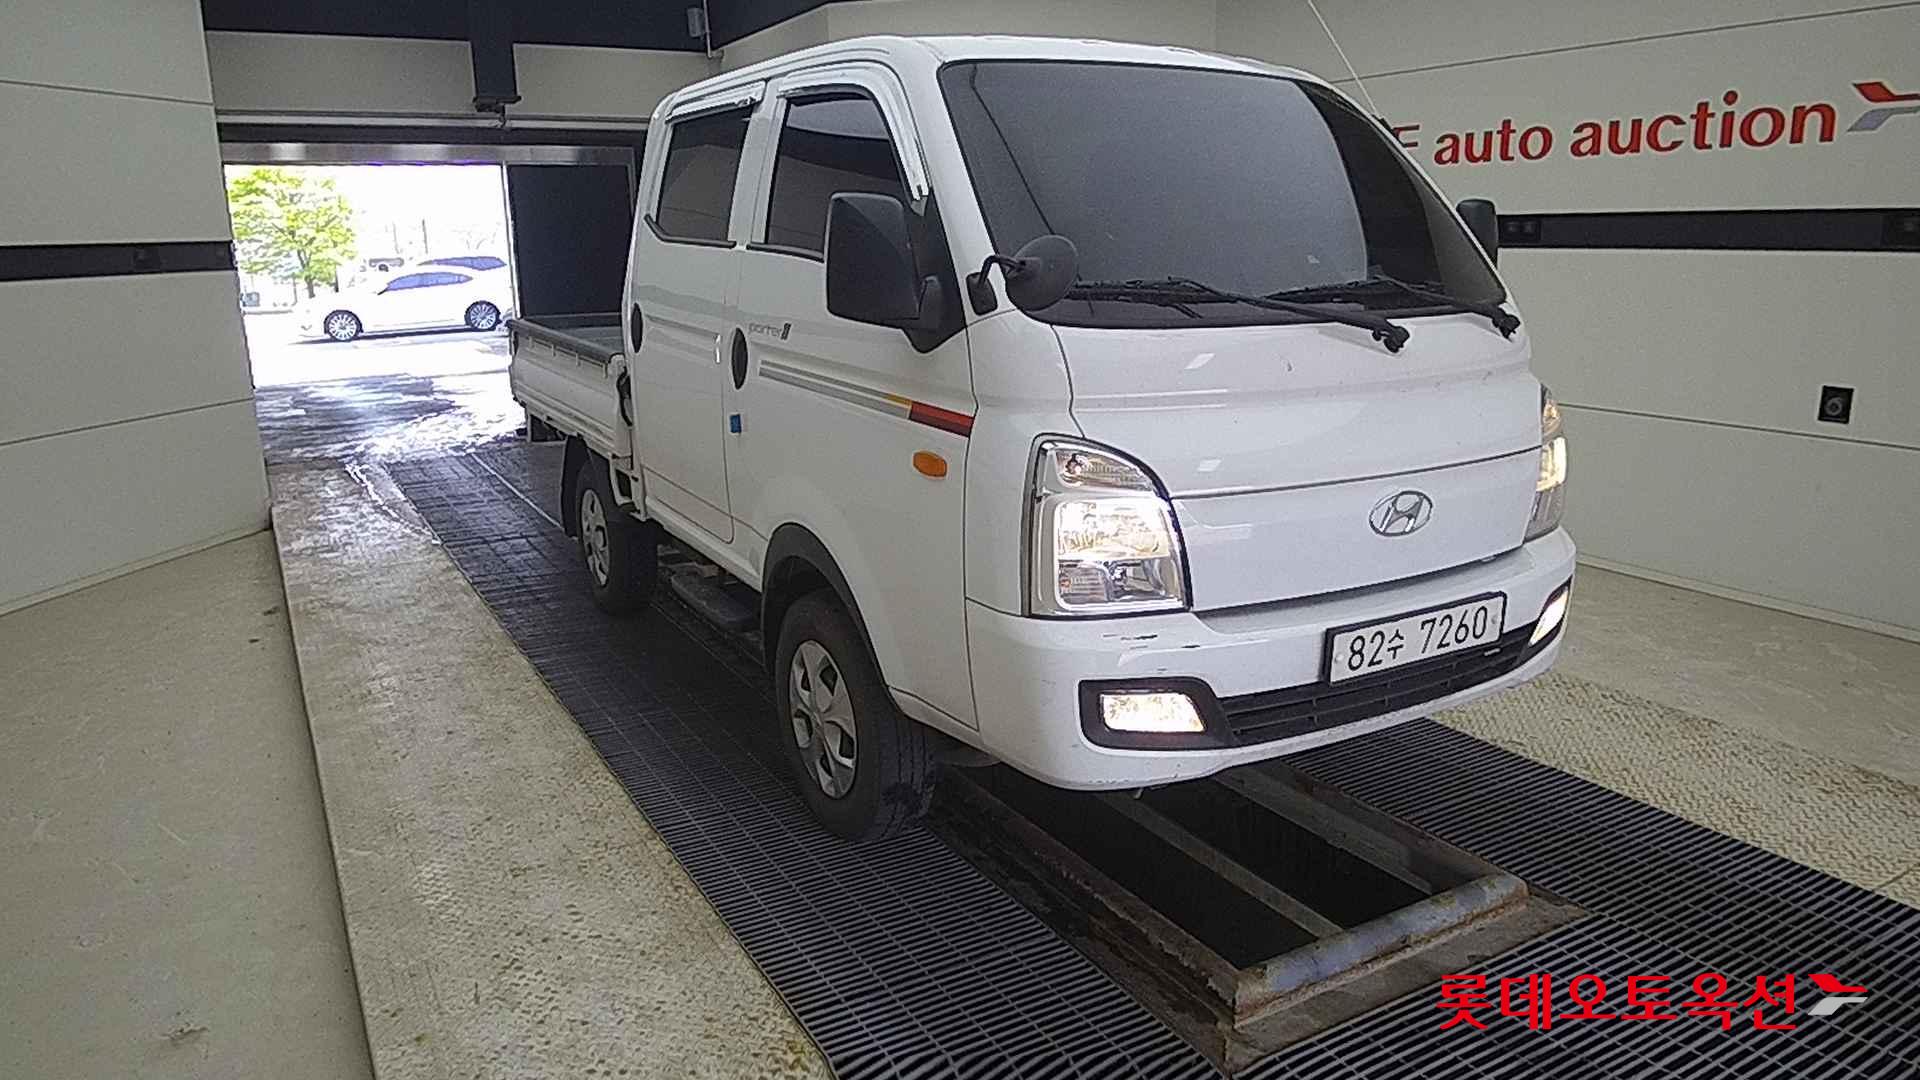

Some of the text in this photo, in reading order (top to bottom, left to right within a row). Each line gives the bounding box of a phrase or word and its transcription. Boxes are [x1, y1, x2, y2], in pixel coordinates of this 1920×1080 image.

[1433, 119, 1553, 166] auto
[1569, 90, 1837, 158] auction
[1347, 605, 1488, 671] 82수 7260
